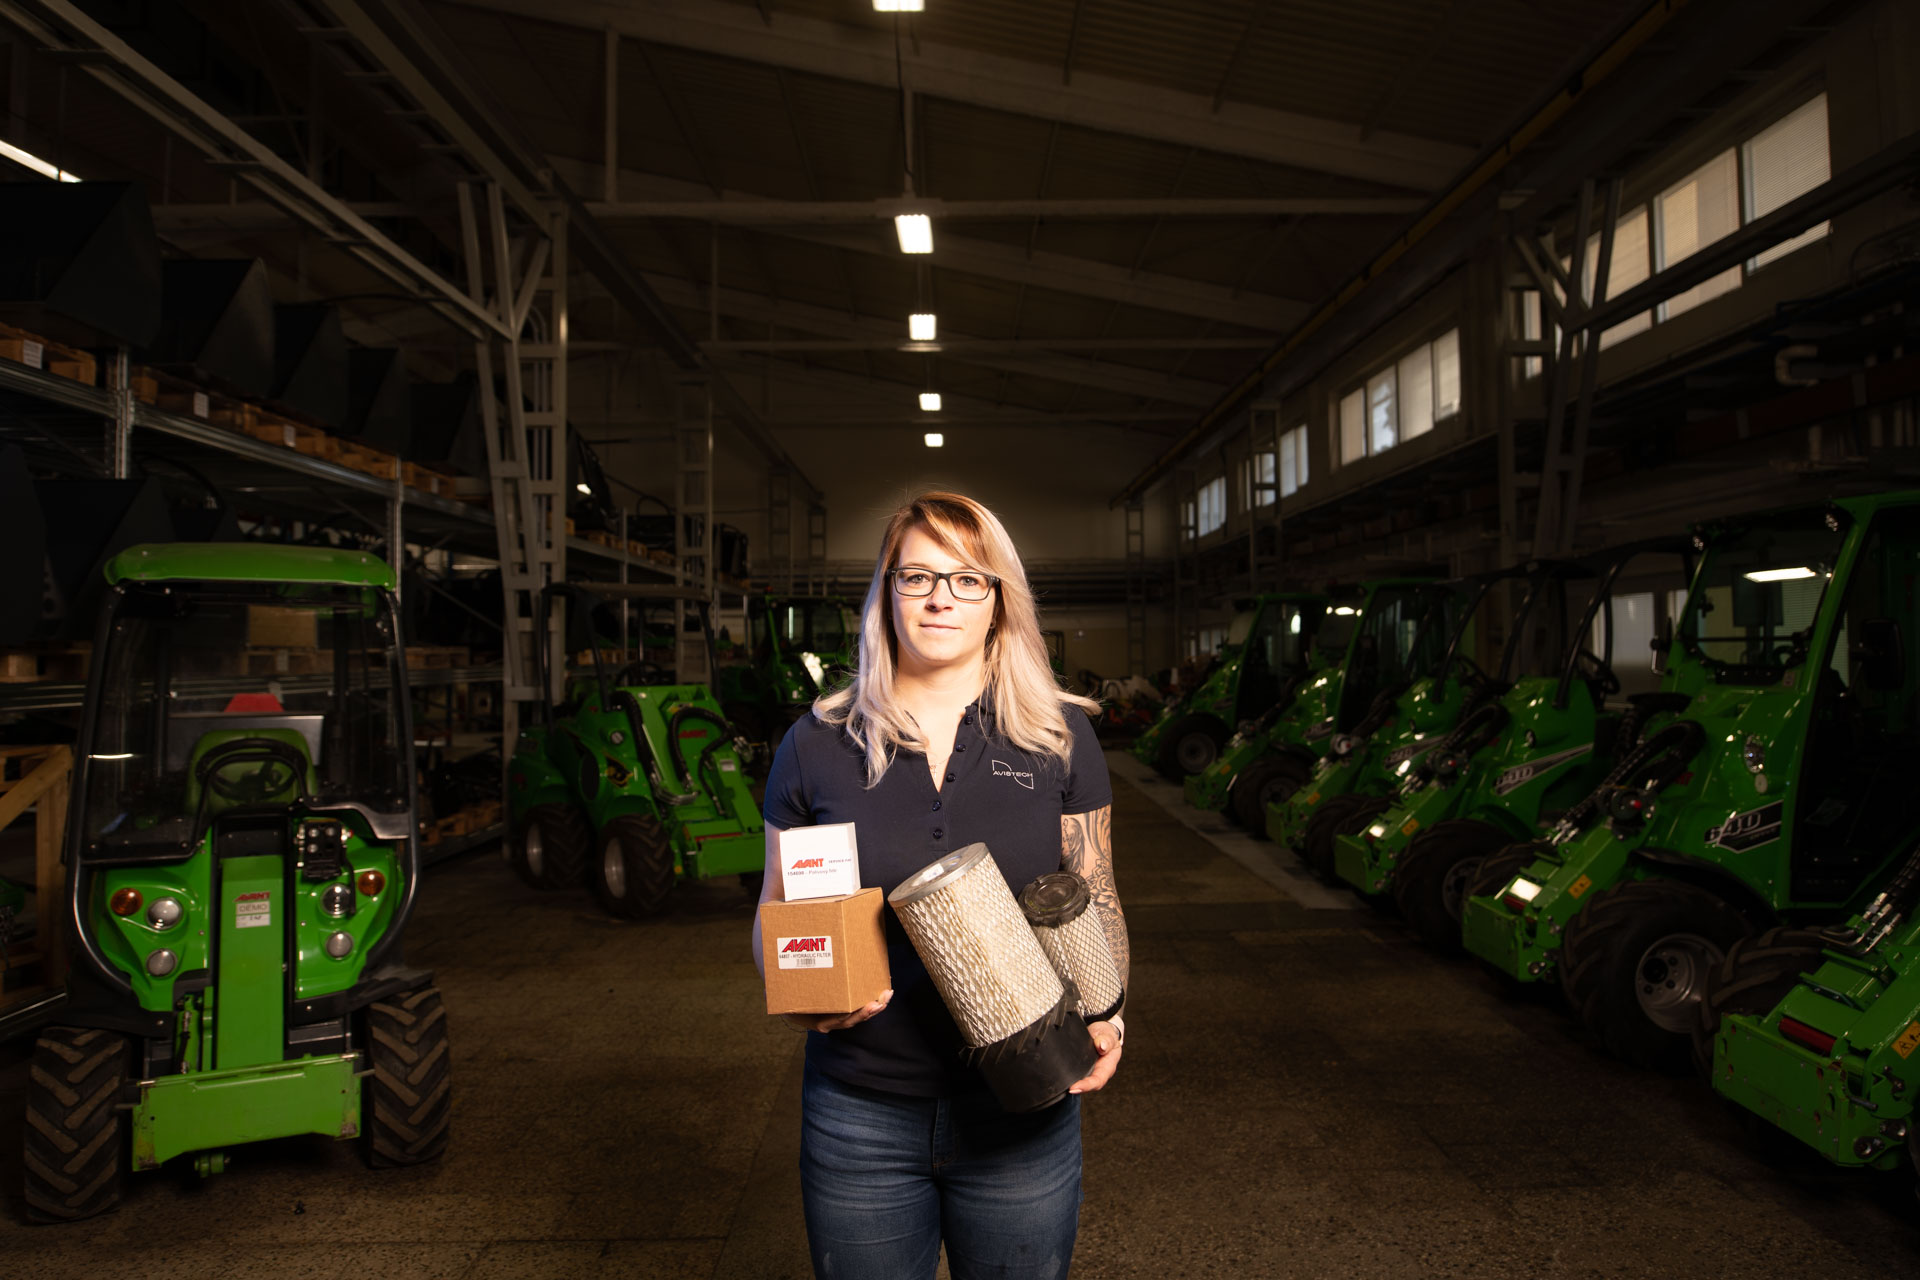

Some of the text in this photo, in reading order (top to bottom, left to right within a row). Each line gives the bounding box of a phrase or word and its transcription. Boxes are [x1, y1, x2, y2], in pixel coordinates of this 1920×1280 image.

[790, 857, 824, 869] AVANT
[239, 903, 268, 912] DEMO
[781, 938, 826, 952] AVANT
